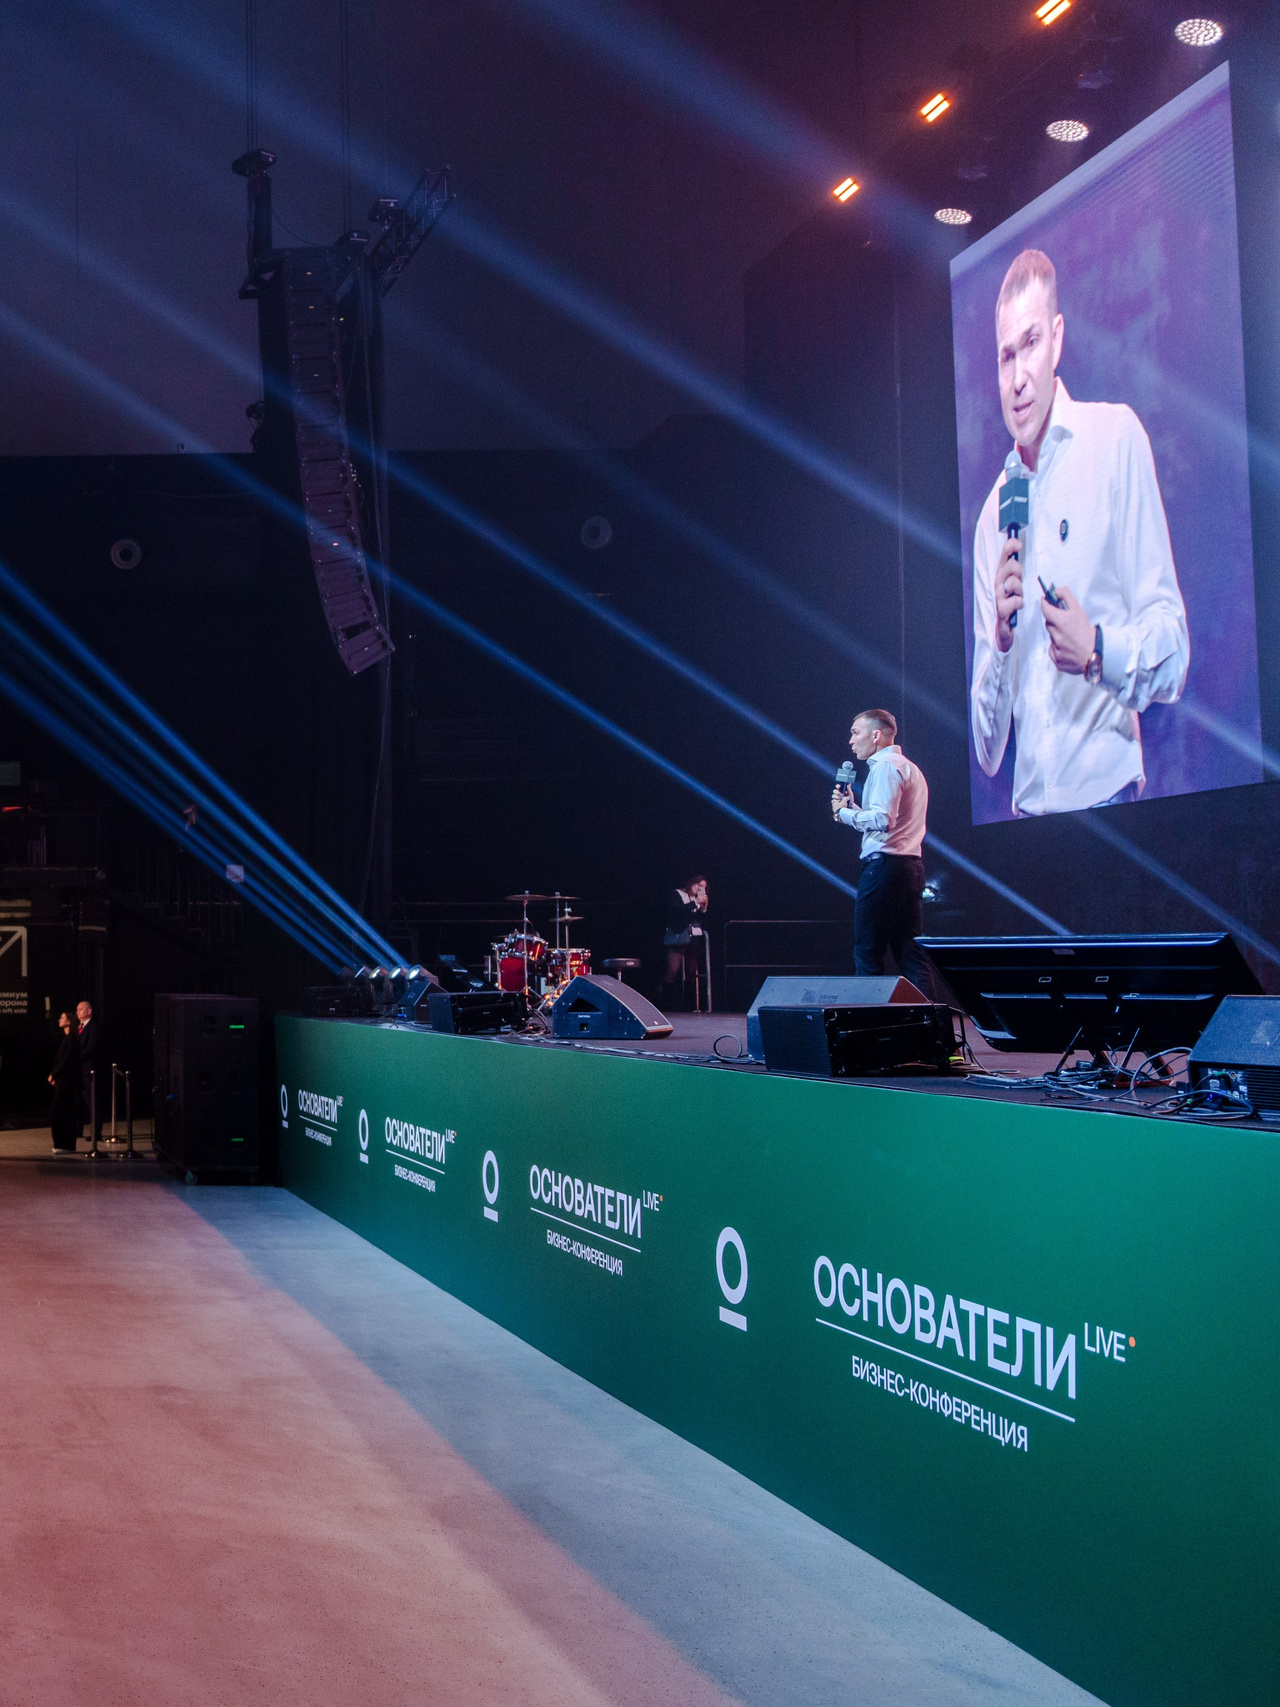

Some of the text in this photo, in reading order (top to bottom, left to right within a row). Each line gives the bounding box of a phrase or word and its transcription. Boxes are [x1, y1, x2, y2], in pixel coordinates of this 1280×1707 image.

[384, 1116, 456, 1165] ОСНОВАТЕЛИ LIVE
[529, 1164, 660, 1239] ОСНОВАТЕЛИ LIVE
[546, 1229, 623, 1277] БИЗНЕС-КОНФЕРЕНЦИЯ
[813, 1255, 1126, 1400] ОСНОВАТЕЛИ LIVE
[852, 1355, 1028, 1452] БИЗНЕС-КОНФЕРЕНЦИЯ
